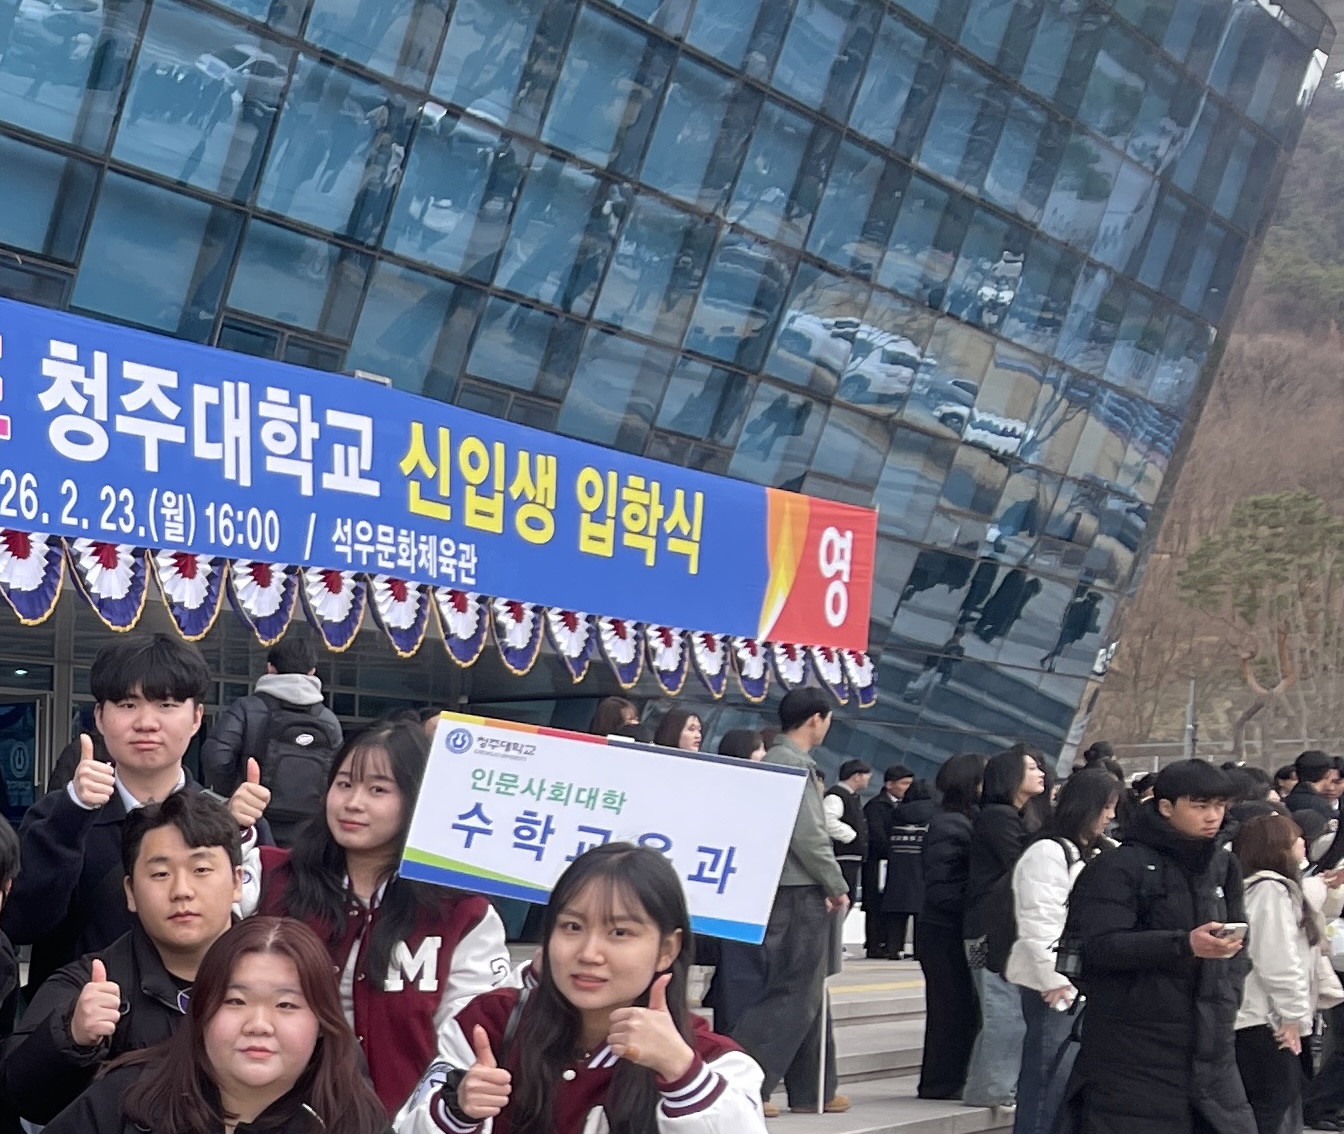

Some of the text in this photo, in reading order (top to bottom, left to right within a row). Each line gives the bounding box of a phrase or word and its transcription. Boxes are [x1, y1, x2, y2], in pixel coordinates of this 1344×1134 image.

[37, 339, 380, 499] 청주대학교
[399, 420, 560, 546] 신입생
[574, 465, 705, 575] 입학식
[205, 502, 280, 552] 16:00
[332, 517, 478, 586] 석우문화체육관
[818, 524, 853, 629] 영
[471, 766, 628, 816] 인문사회대학
[384, 936, 442, 992] M
